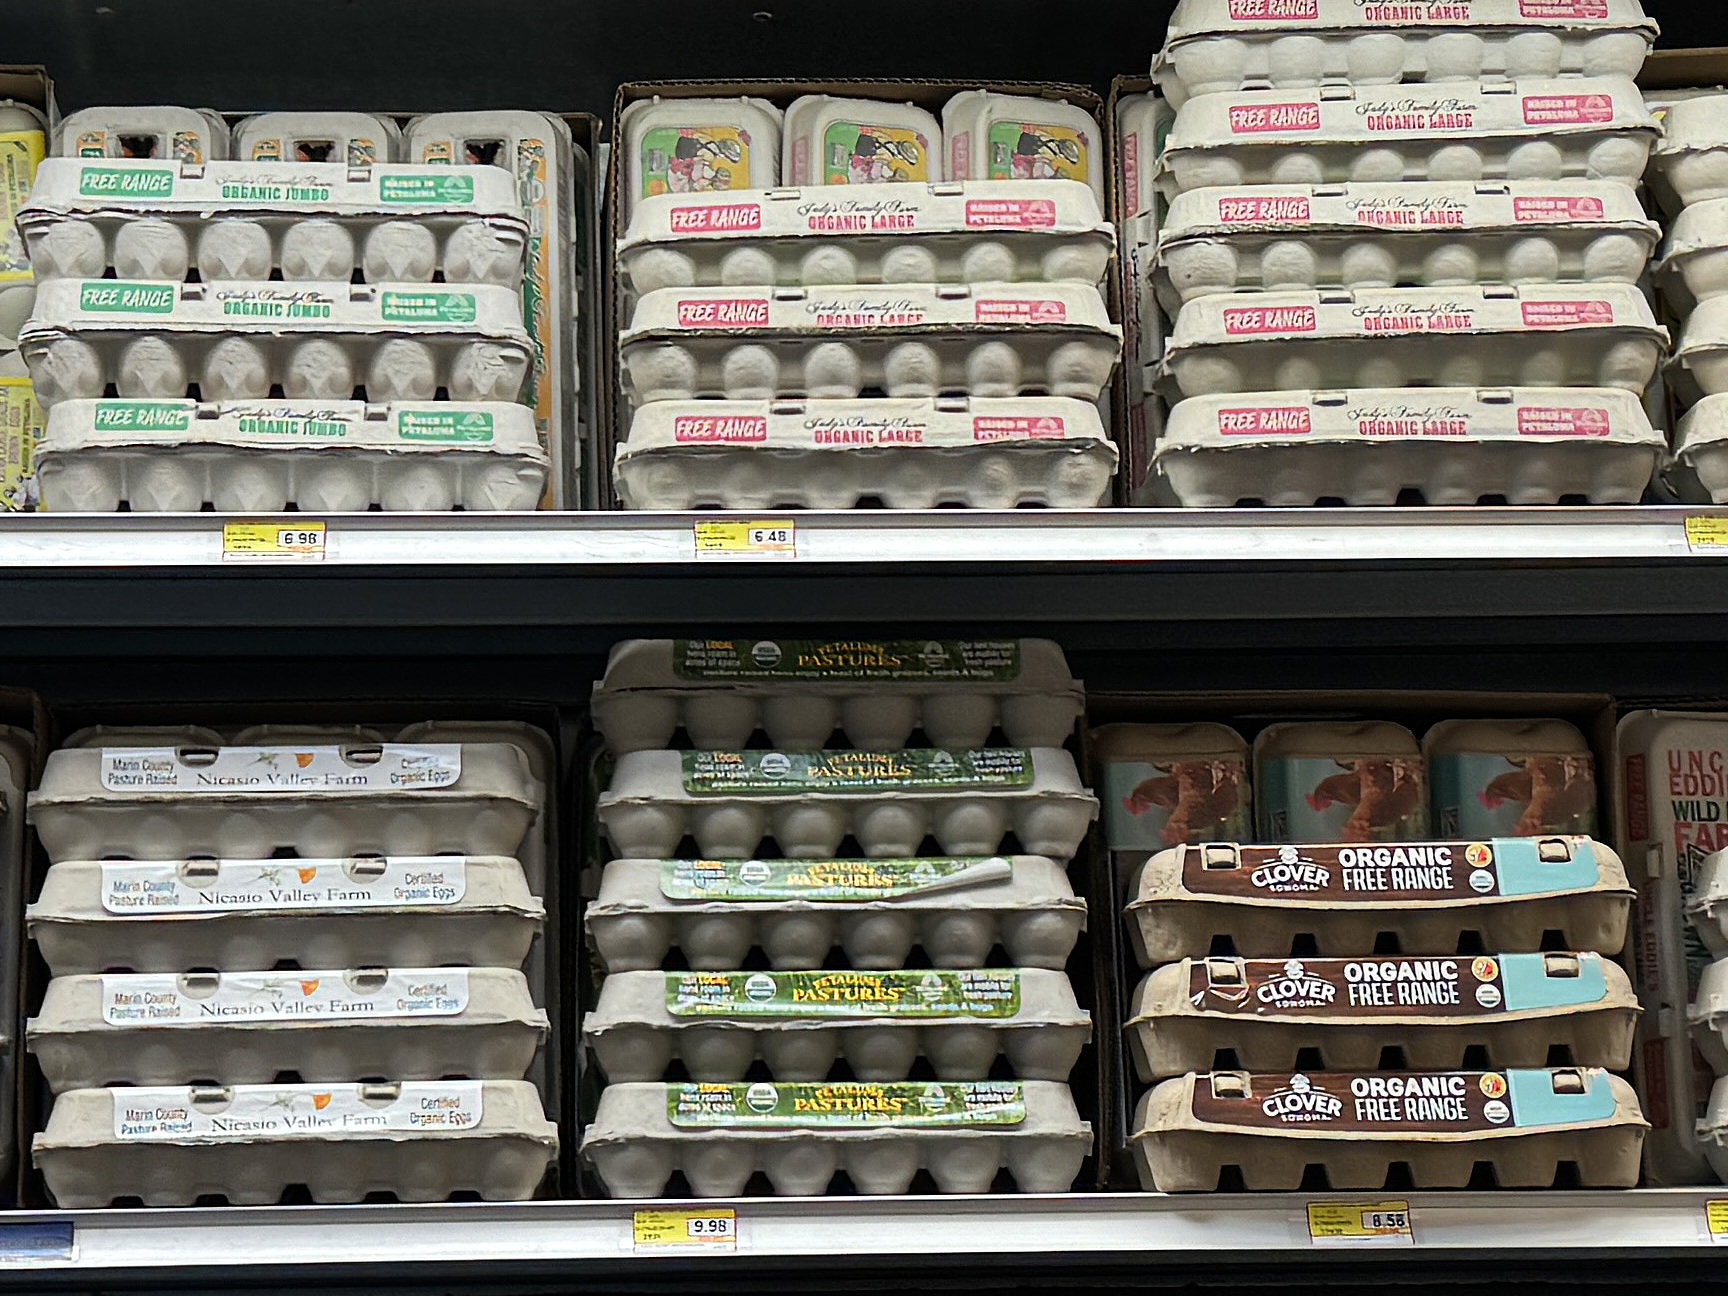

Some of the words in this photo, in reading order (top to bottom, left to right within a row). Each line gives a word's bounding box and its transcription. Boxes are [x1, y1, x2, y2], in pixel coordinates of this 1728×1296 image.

[1230, 0, 1266, 18] FREE
[1230, 109, 1266, 127] FREE
[1269, 107, 1318, 127] RANGE
[81, 172, 117, 191] FREE
[120, 171, 171, 193] RANGE
[221, 185, 280, 200] ORGANIC
[285, 186, 329, 202] JUMBO
[673, 210, 709, 229] FREE
[712, 208, 759, 227] RANGE
[83, 288, 117, 307] FREE
[120, 288, 172, 309] RANGE
[223, 302, 282, 317] ORGANIC
[286, 304, 331, 319] JUMBO
[97, 407, 133, 426] FREE
[135, 406, 185, 427] RANGE
[1220, 414, 1256, 431] FREE
[1259, 412, 1309, 431] RANGE
[238, 419, 298, 435] ORGANIC
[303, 421, 347, 436] JUMBO
[676, 419, 712, 438] FREE
[715, 419, 764, 438] RANGE
[799, 654, 902, 667] PASTURES
[1672, 800, 1720, 822] WILD
[1339, 847, 1452, 867] ORGANIC
[1251, 865, 1330, 887] CLOVER
[1342, 867, 1388, 891] FREE
[1392, 866, 1454, 890] RANGE
[199, 891, 263, 905] Nicasio
[269, 890, 322, 904] Valley
[327, 889, 371, 902] Farm
[1344, 961, 1458, 982] ORGANIC
[1257, 979, 1336, 1002] CLOVER
[1348, 982, 1394, 1006] FREE
[1398, 981, 1460, 1005] RANGE
[1351, 1076, 1466, 1097] ORGANIC
[794, 1096, 903, 1112] PASTURES
[1262, 1094, 1342, 1117] CLOVER
[1355, 1097, 1402, 1122] FREE
[1405, 1096, 1468, 1121] RANGE
[693, 1219, 729, 1233] 9.98
